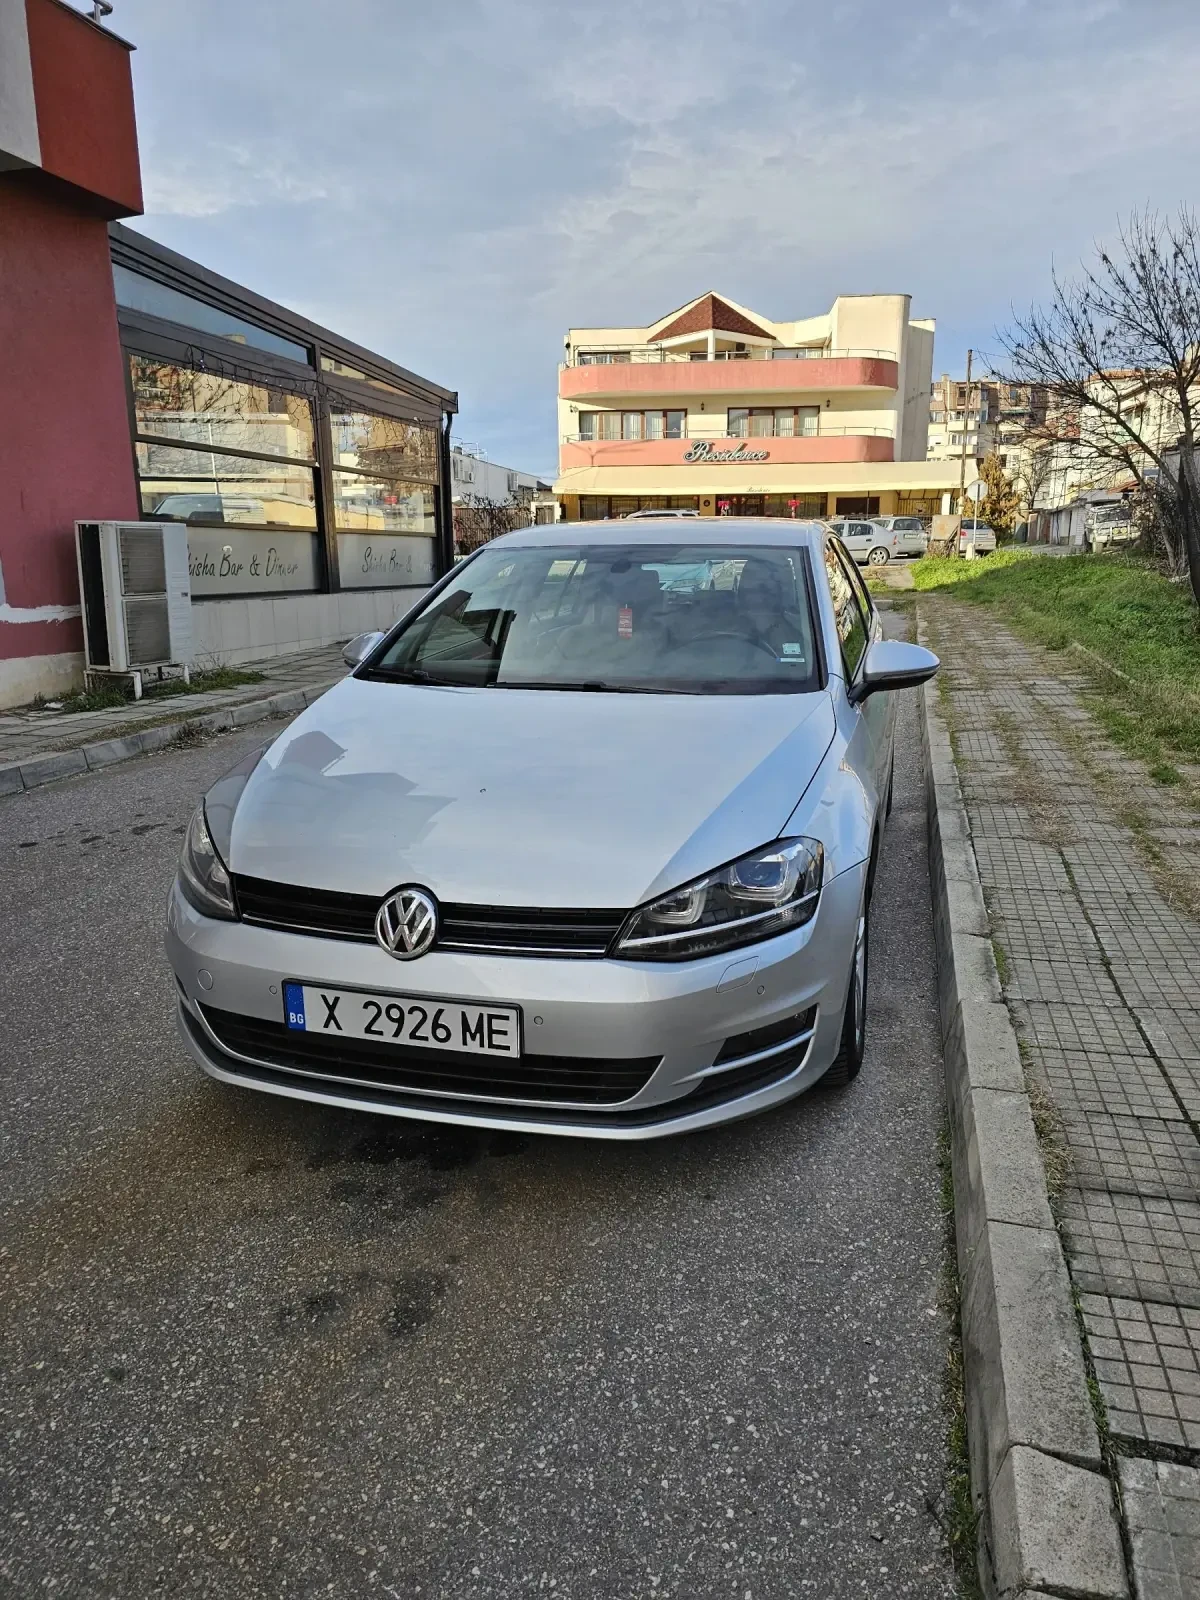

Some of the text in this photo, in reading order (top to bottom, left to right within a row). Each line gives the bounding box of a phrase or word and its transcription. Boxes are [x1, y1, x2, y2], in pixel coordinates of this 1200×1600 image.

[684, 440, 768, 462] Residence
[187, 544, 216, 577] hisha
[219, 546, 244, 577] Bar
[249, 554, 262, 576] &
[289, 1011, 304, 1025] BG
[320, 993, 512, 1052] X 2926 ME
